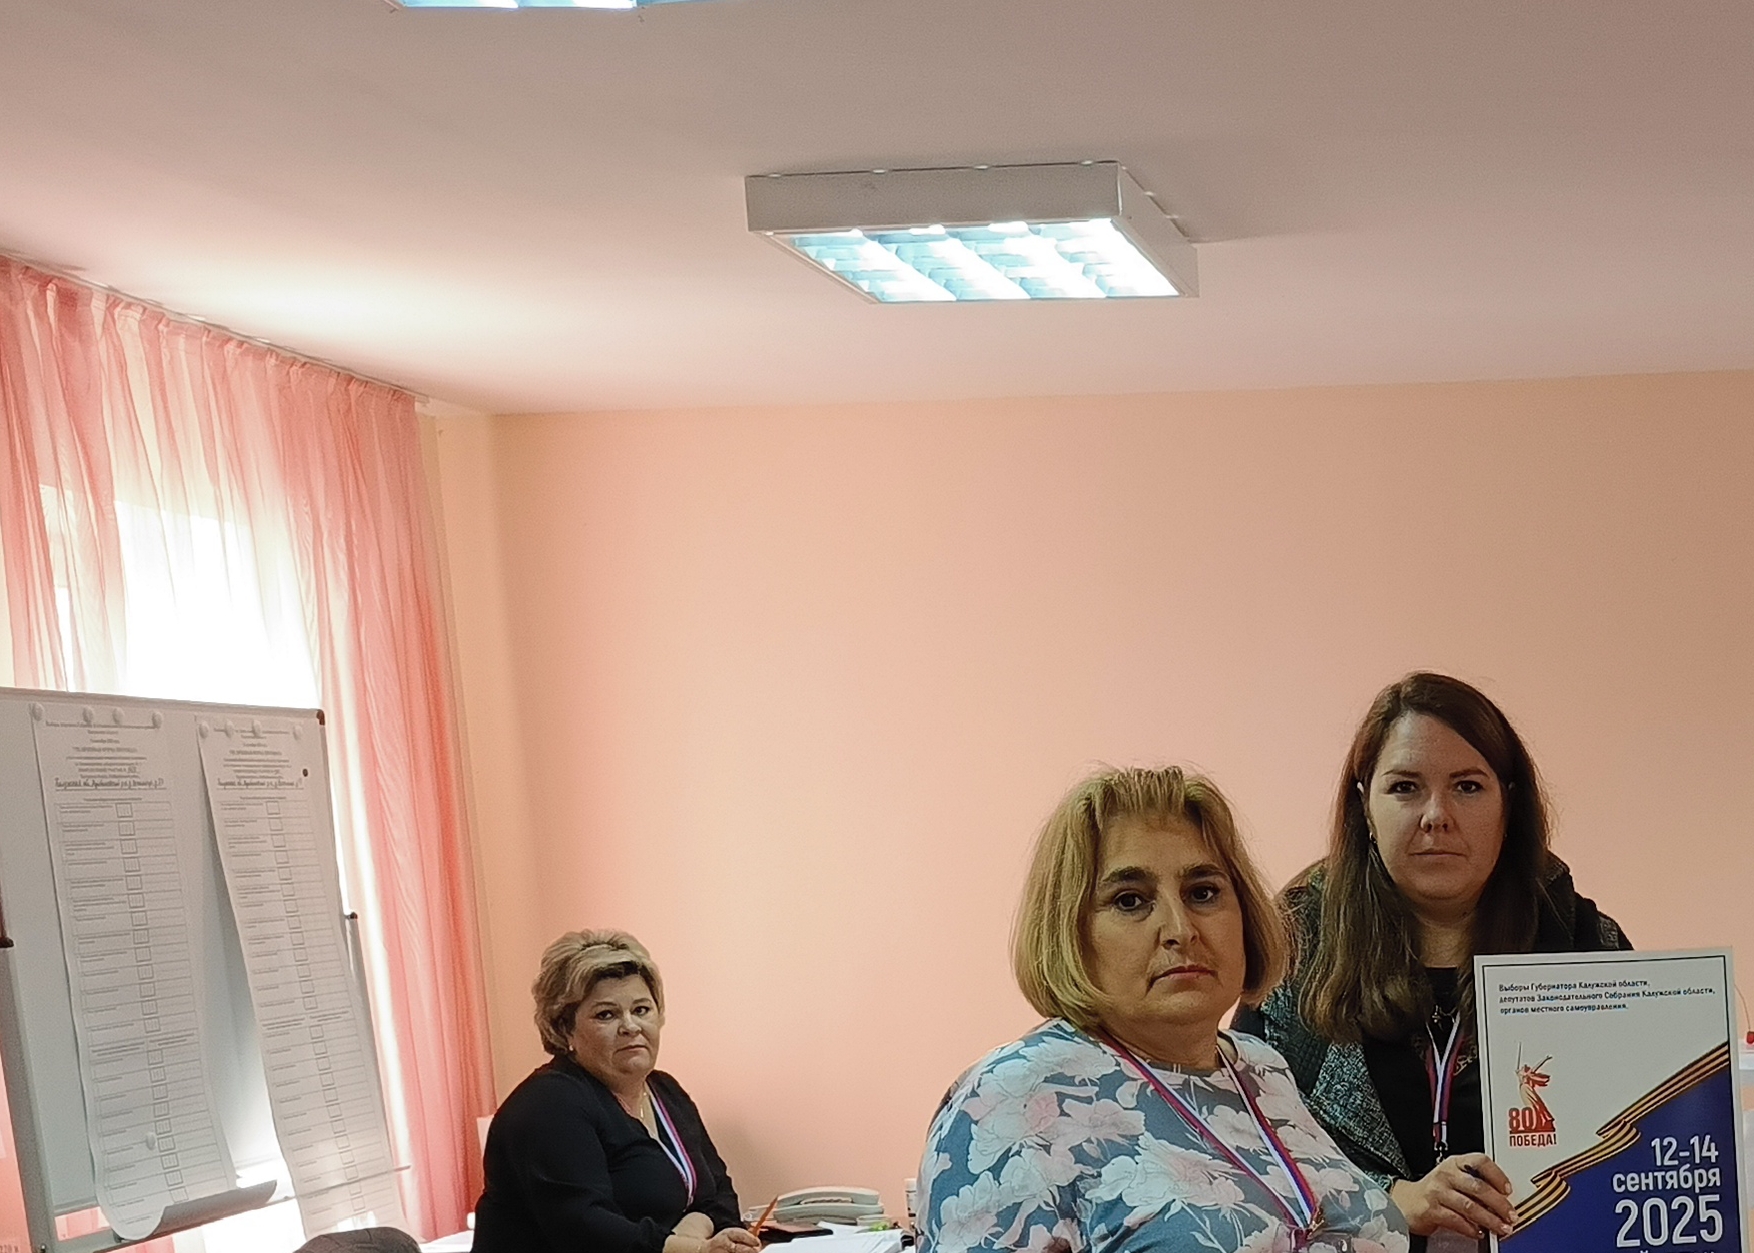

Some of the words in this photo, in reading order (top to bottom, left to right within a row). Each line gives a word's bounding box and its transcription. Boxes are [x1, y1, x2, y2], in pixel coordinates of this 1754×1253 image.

[1499, 983, 1529, 992] Выборы
[1531, 981, 1577, 992] Губернатора
[1579, 980, 1617, 990] Калужской
[1499, 995, 1535, 1004] депутатов
[1537, 992, 1603, 1003] Законодательного
[1604, 990, 1641, 1000] Собрания
[1642, 987, 1681, 998] Калужской
[1500, 1005, 1529, 1015] органов
[1530, 1004, 1564, 1013] местного
[1508, 1107, 1534, 1133] 80
[1509, 1132, 1558, 1148] ПОБЕДА!
[1651, 1134, 1719, 1167] 12-14
[1612, 1163, 1721, 1193] сентября
[1614, 1193, 1724, 1248] 2025
